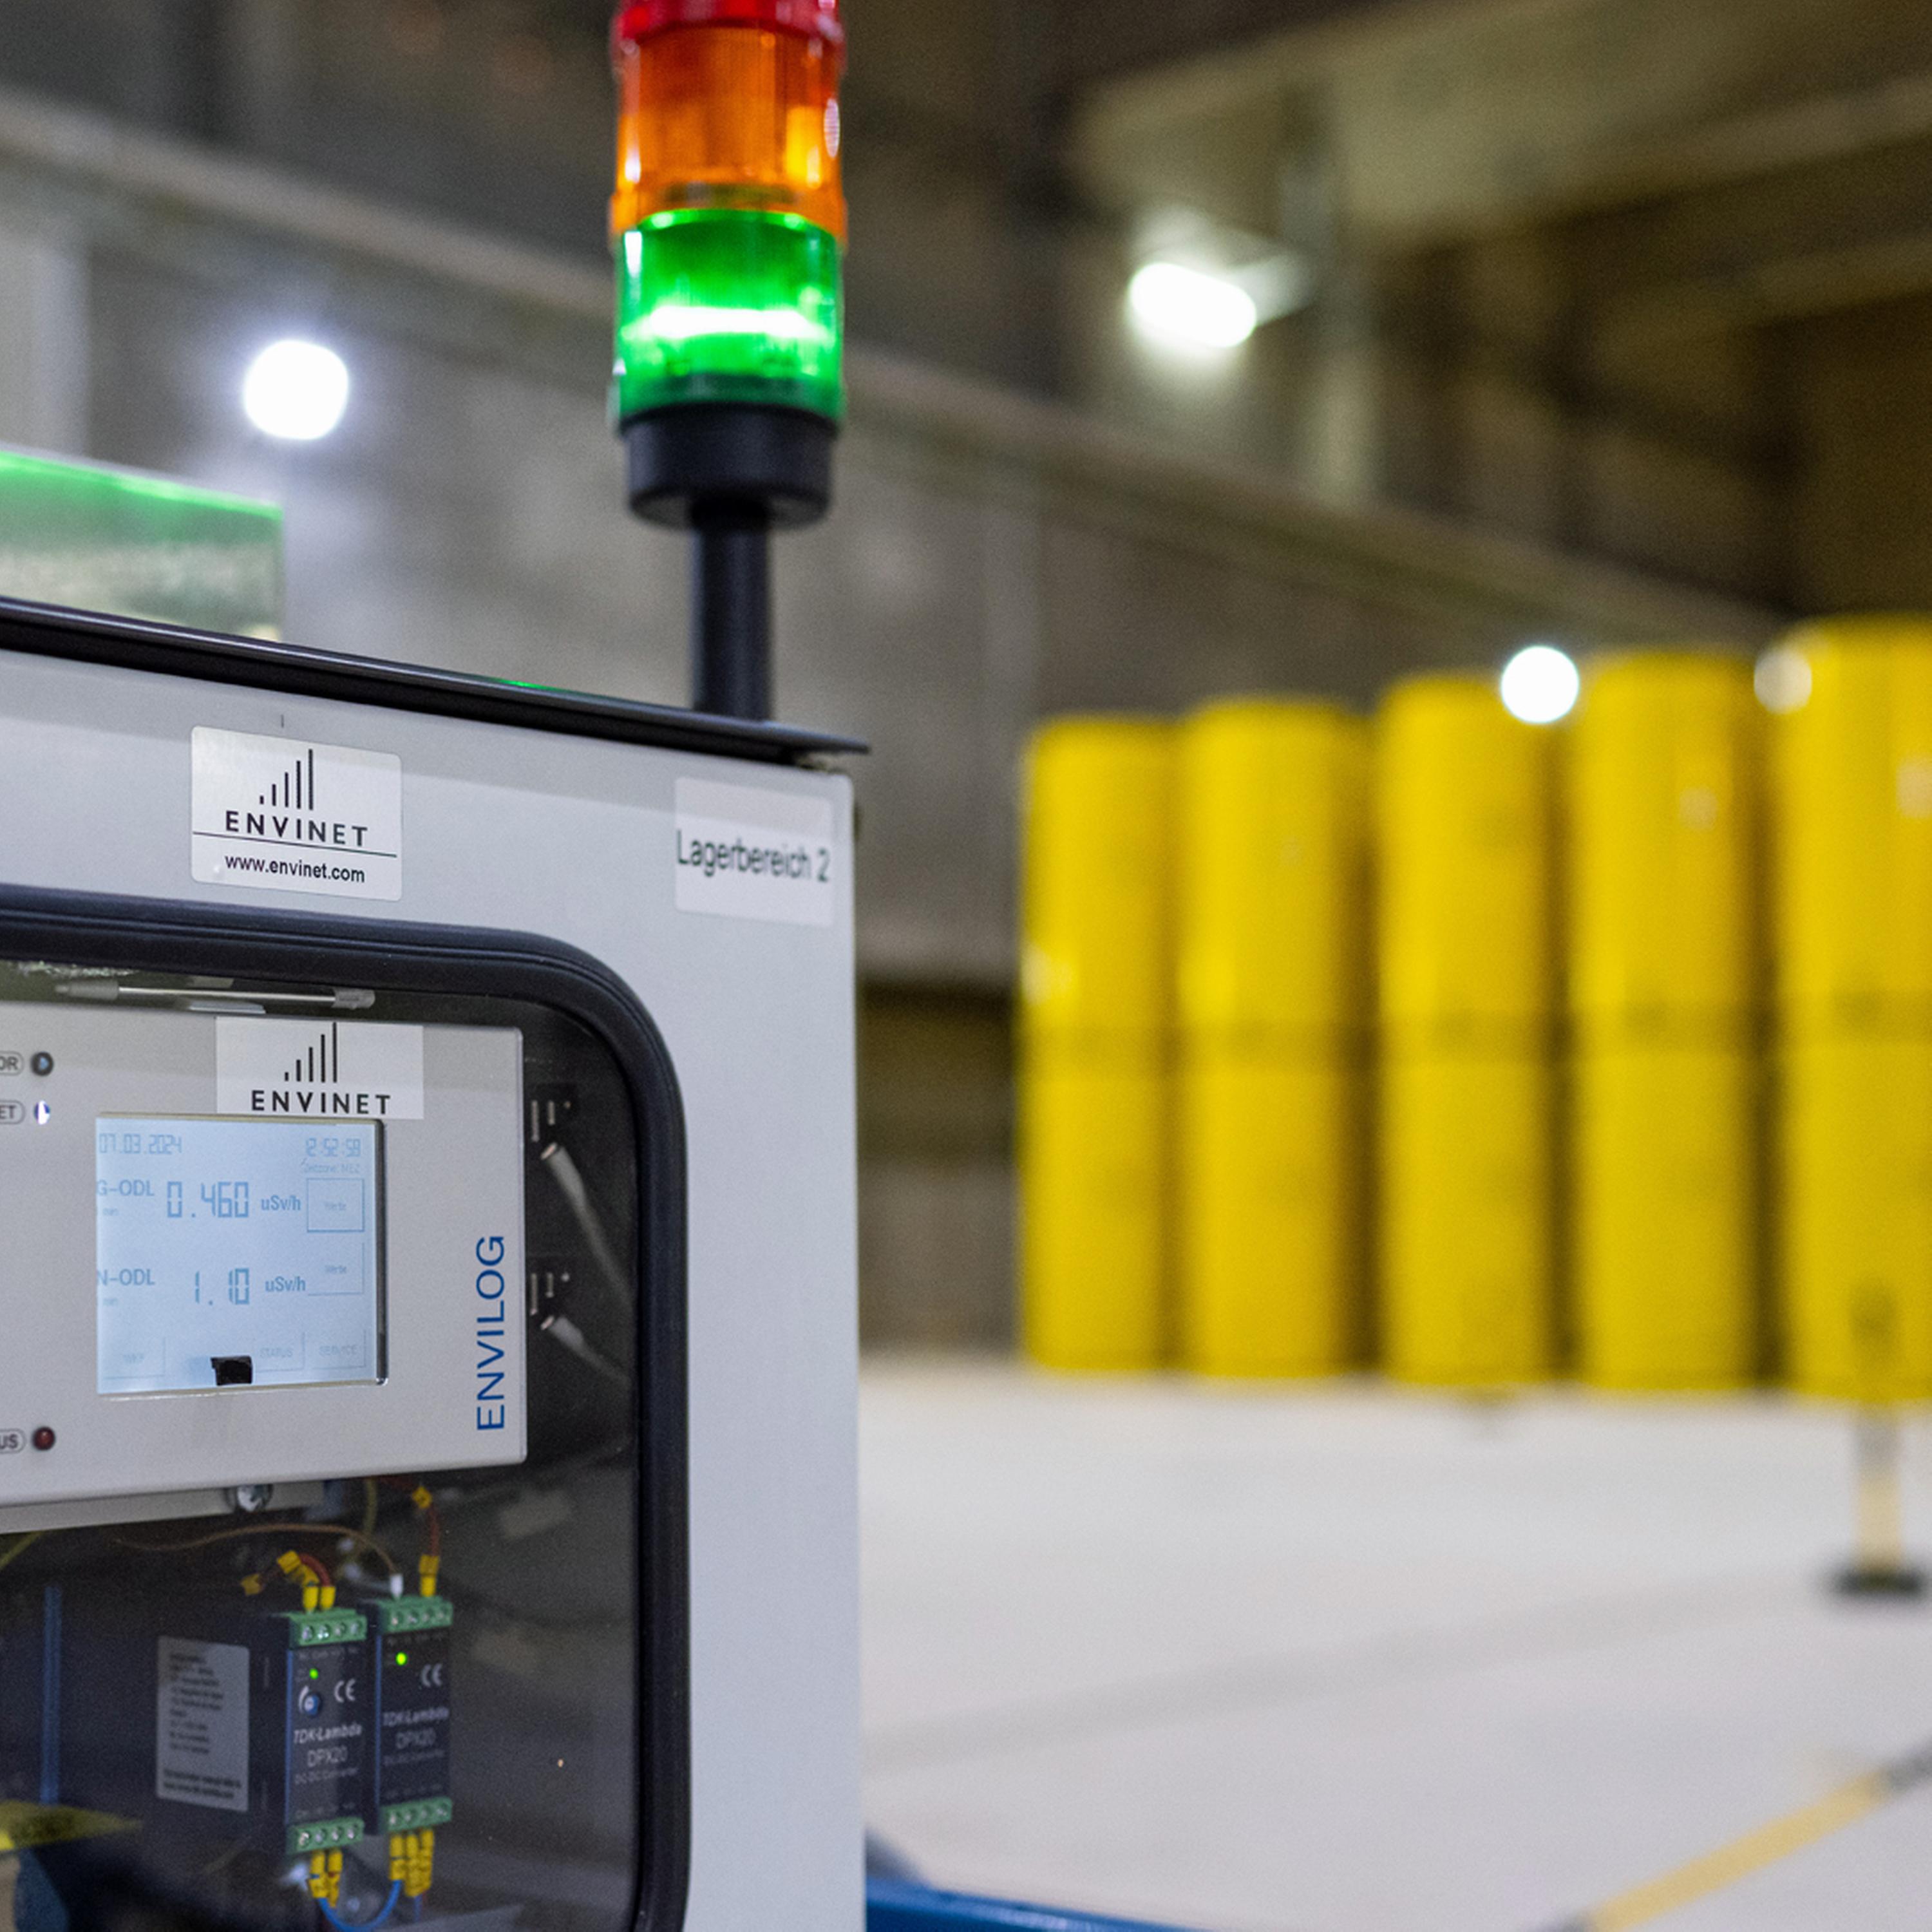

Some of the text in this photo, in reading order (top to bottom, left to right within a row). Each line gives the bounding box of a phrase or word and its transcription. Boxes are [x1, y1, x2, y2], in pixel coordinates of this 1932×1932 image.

[225, 810, 368, 846] ENVINET
[225, 855, 365, 883] www.envinet.com
[676, 829, 830, 883] Lagerbereich 2
[251, 1090, 391, 1115] ENVINET
[97, 1179, 302, 1218] G-ODL 0.460 uSv/h
[97, 1267, 306, 1305] N-ODL 1.10 uSv/h
[475, 1236, 505, 1430] ENVILOG
